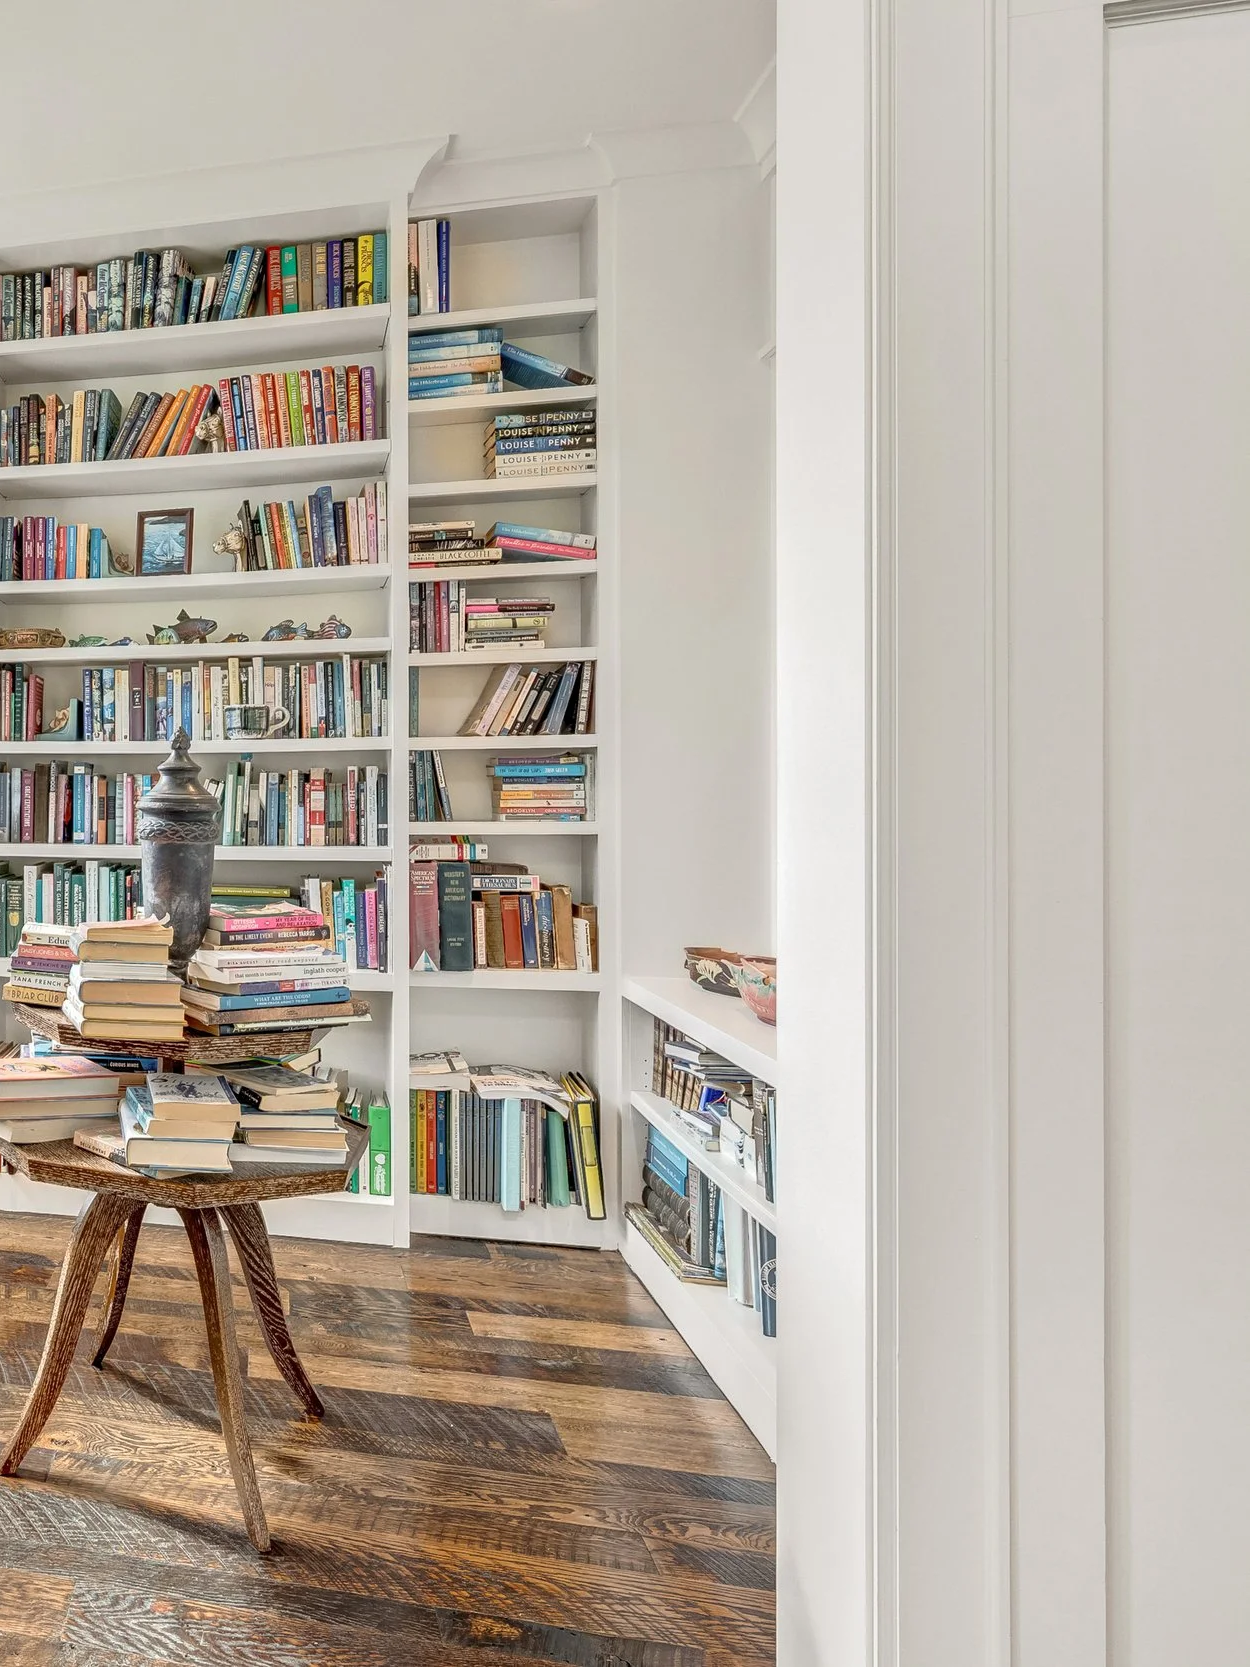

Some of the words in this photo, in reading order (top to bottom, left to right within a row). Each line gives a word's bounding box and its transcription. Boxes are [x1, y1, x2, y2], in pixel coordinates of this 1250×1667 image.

[333, 257, 341, 278] FRANCIS
[344, 269, 355, 288] FORCE
[285, 284, 294, 299] BOLT
[336, 373, 346, 391] JANET
[349, 372, 358, 390] JANET
[337, 391, 347, 422] EVANOVICH
[349, 390, 358, 423] EVANOVICH
[149, 397, 170, 432] JACQUELINE
[546, 412, 580, 421] PENNY
[499, 427, 532, 436] LOUISE
[546, 424, 579, 433] PENNY
[500, 440, 534, 450] LOUISE
[548, 437, 580, 446] PENNY
[503, 455, 537, 464] LOUISE
[548, 452, 581, 461] PENNY
[503, 468, 539, 476] LOUISE
[549, 464, 583, 473] PENNY
[530, 542, 555, 550] Paradise
[439, 551, 463, 560] BLACK
[464, 550, 490, 559] COFFEE
[303, 967, 324, 976] inglath
[325, 966, 345, 975] cooper
[34, 978, 61, 987] FRENCH
[11, 989, 35, 999] BRIAR
[37, 992, 59, 1002] CLUB
[92, 1146, 106, 1154] OWENS
